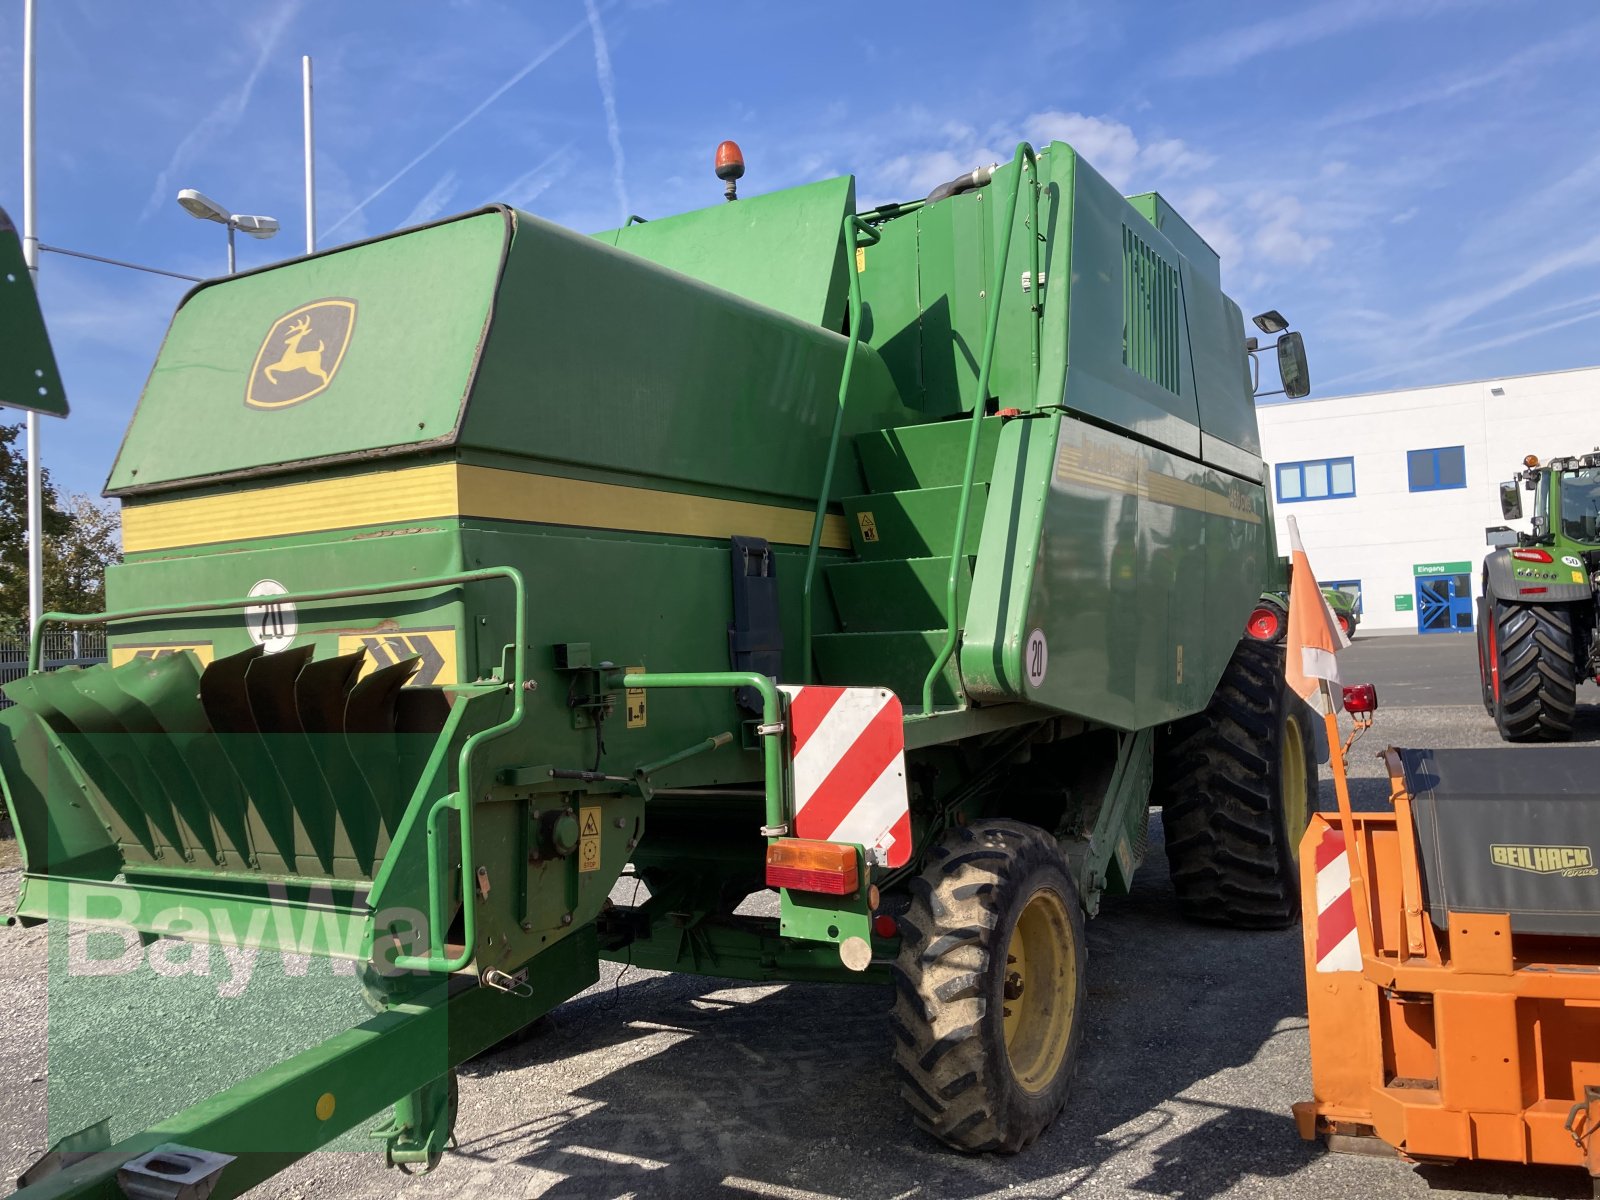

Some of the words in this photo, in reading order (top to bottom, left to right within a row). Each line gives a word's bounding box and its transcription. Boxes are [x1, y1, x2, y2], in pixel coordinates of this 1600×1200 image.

[1417, 565, 1445, 573] Eingang
[1565, 557, 1579, 566] 50
[259, 604, 285, 639] 20
[1031, 639, 1043, 677] 20
[1493, 847, 1589, 872] BEILHACK
